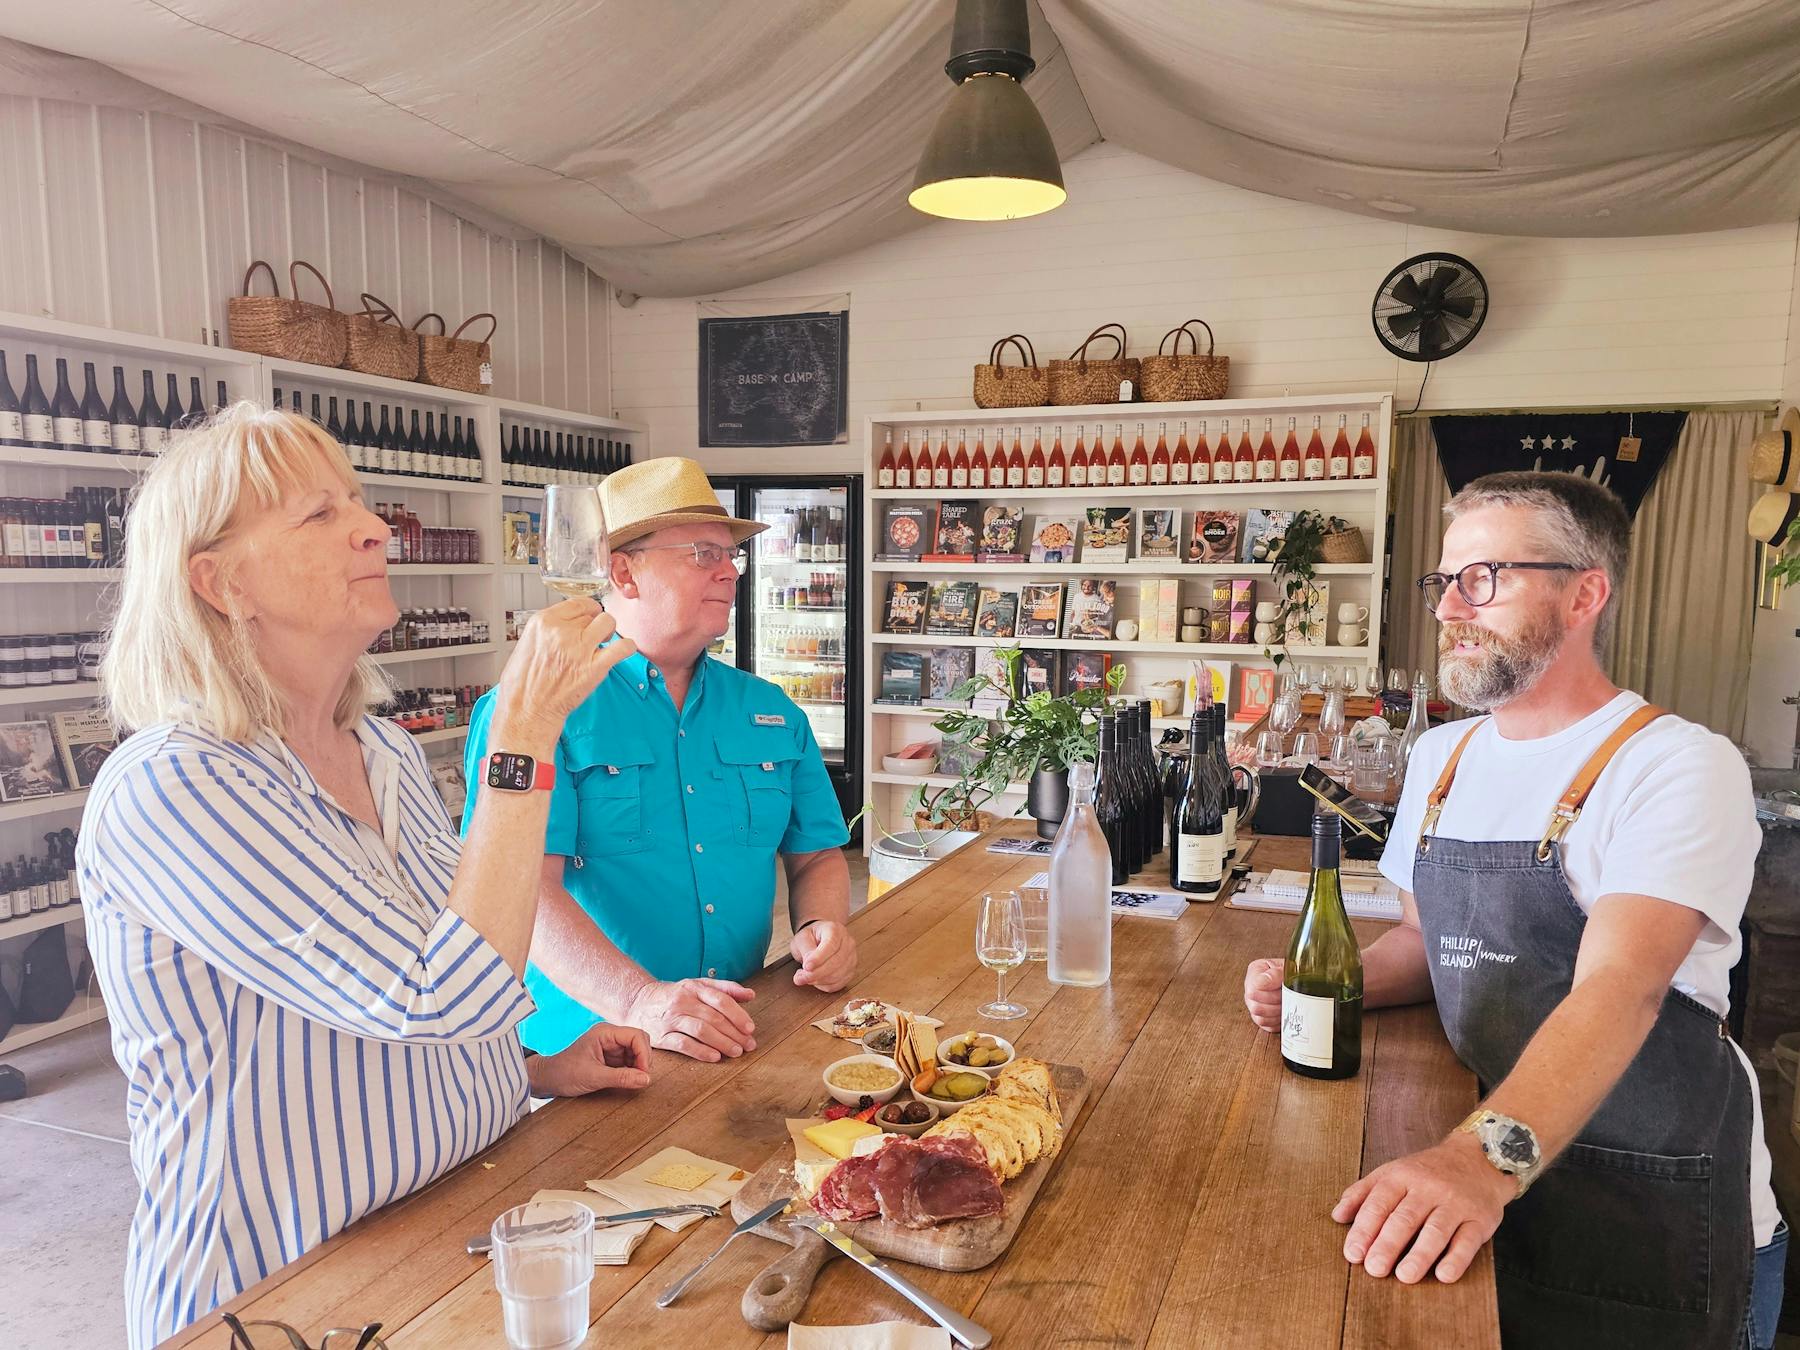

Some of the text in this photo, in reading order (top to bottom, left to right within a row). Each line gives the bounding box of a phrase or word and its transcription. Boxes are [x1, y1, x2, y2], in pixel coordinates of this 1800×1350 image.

[738, 374, 764, 384] BASE
[784, 372, 812, 384] CAMP
[942, 596, 964, 604] FIRE
[1213, 589, 1230, 600] NOIR
[892, 597, 918, 607] BBQ
[1212, 621, 1229, 631] NOIR
[515, 770, 523, 787] 4:47
[1440, 936, 1478, 951] PHILLIP
[1440, 954, 1473, 968] ISLAND
[1480, 951, 1517, 963] WINERY
